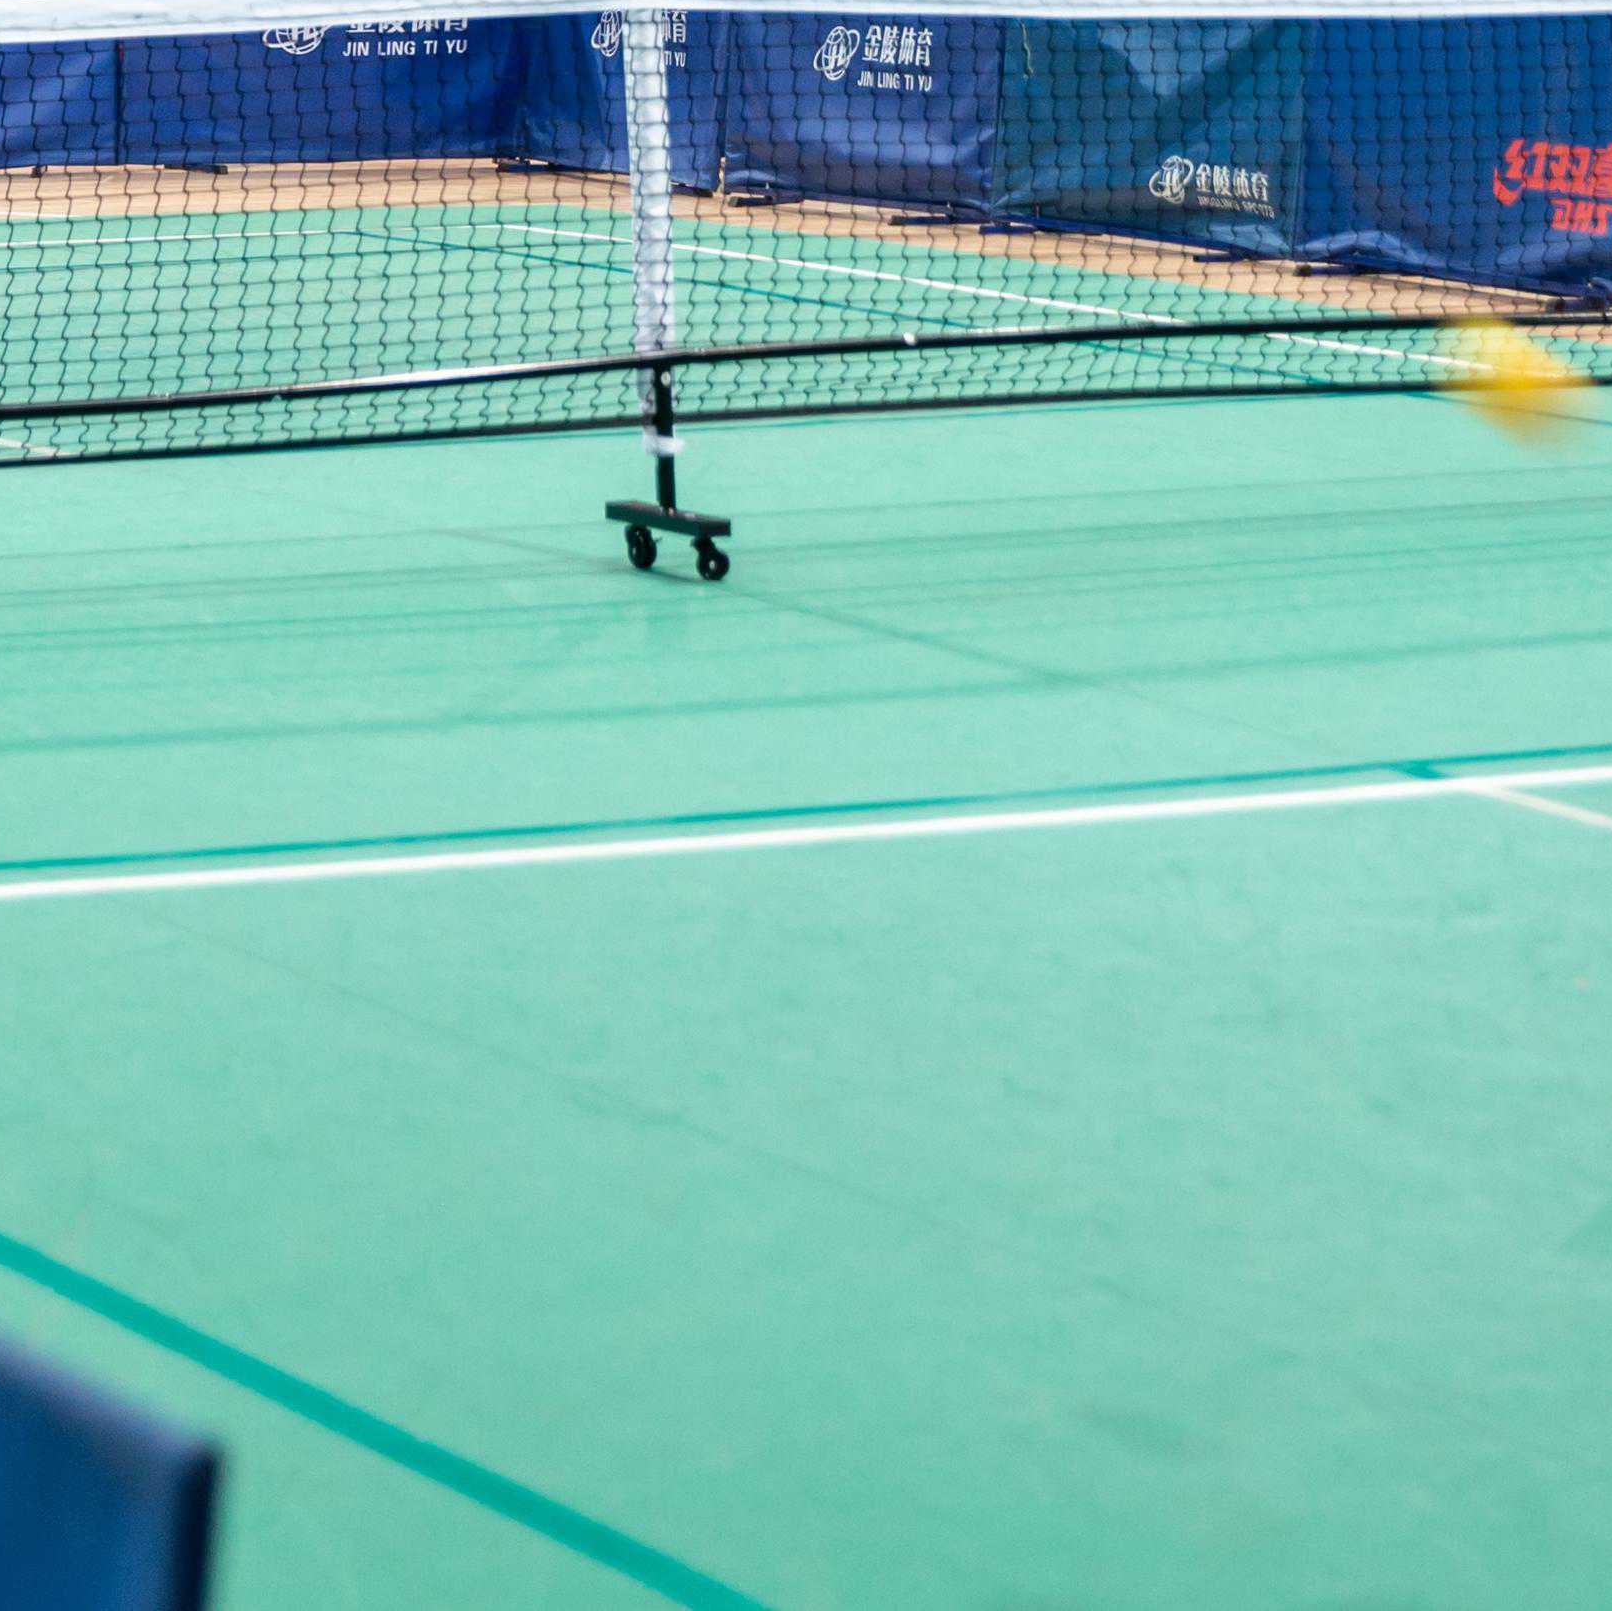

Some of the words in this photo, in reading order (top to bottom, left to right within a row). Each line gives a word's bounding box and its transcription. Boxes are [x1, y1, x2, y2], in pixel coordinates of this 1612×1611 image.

[342, 41, 369, 57] JIN
[378, 40, 416, 56] LING
[424, 39, 438, 55] TI
[446, 39, 468, 54] YU
[862, 25, 933, 67] 金陵体育
[674, 51, 687, 67] YU
[857, 71, 874, 87] JIN
[877, 72, 900, 89] LING
[903, 74, 914, 91] TI
[918, 75, 932, 92] YU
